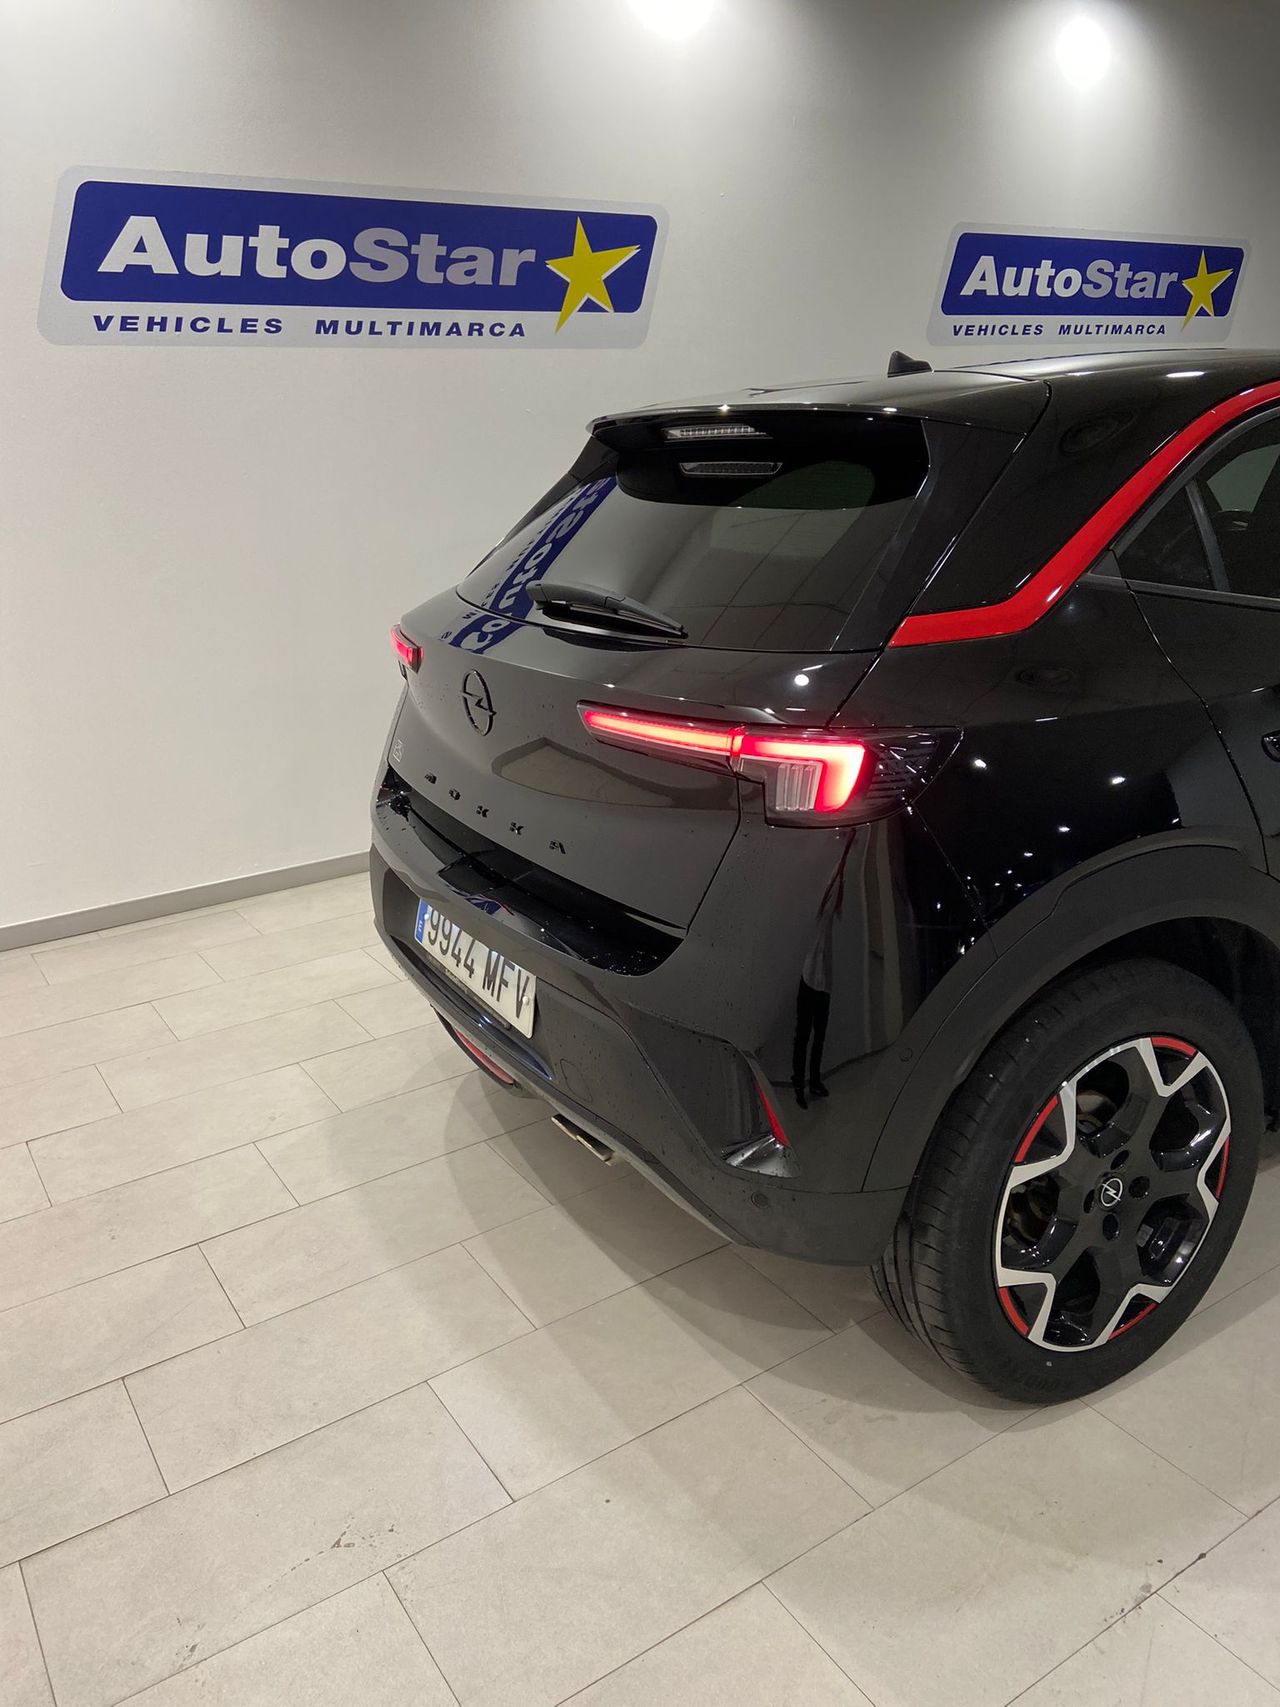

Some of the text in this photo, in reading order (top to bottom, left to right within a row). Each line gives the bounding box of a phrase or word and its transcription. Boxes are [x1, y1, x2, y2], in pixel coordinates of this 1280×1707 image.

[98, 215, 536, 286] AutoStar
[960, 255, 1179, 299] AutoStar
[93, 315, 526, 337] VEHICLES MULTIMARCA
[952, 324, 1166, 337] VEHICLES MULTIMARCA
[428, 909, 530, 1019] 9944 MFV
